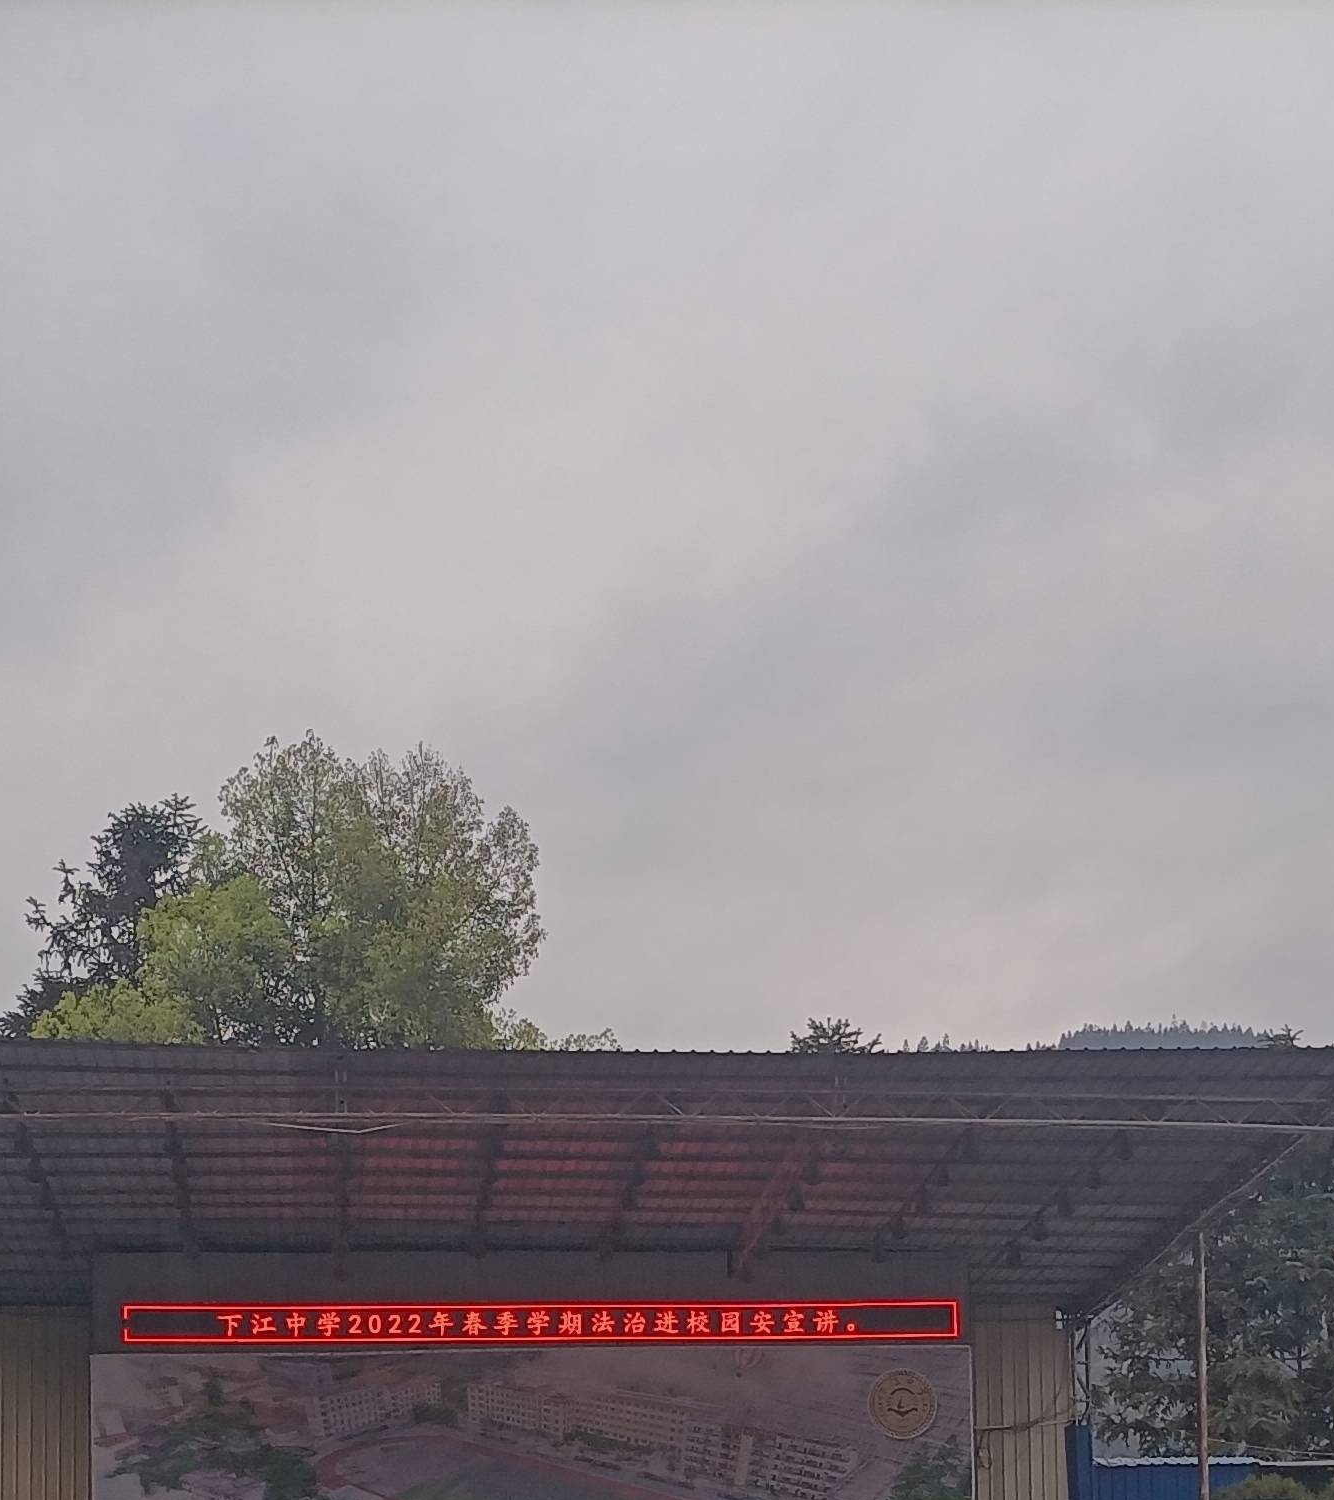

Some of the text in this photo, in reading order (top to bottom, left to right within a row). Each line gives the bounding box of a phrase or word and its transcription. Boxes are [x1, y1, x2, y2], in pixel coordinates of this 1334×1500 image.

[217, 1310, 858, 1336] 下江中学2022年春季学期法治进校园安宣讲。
